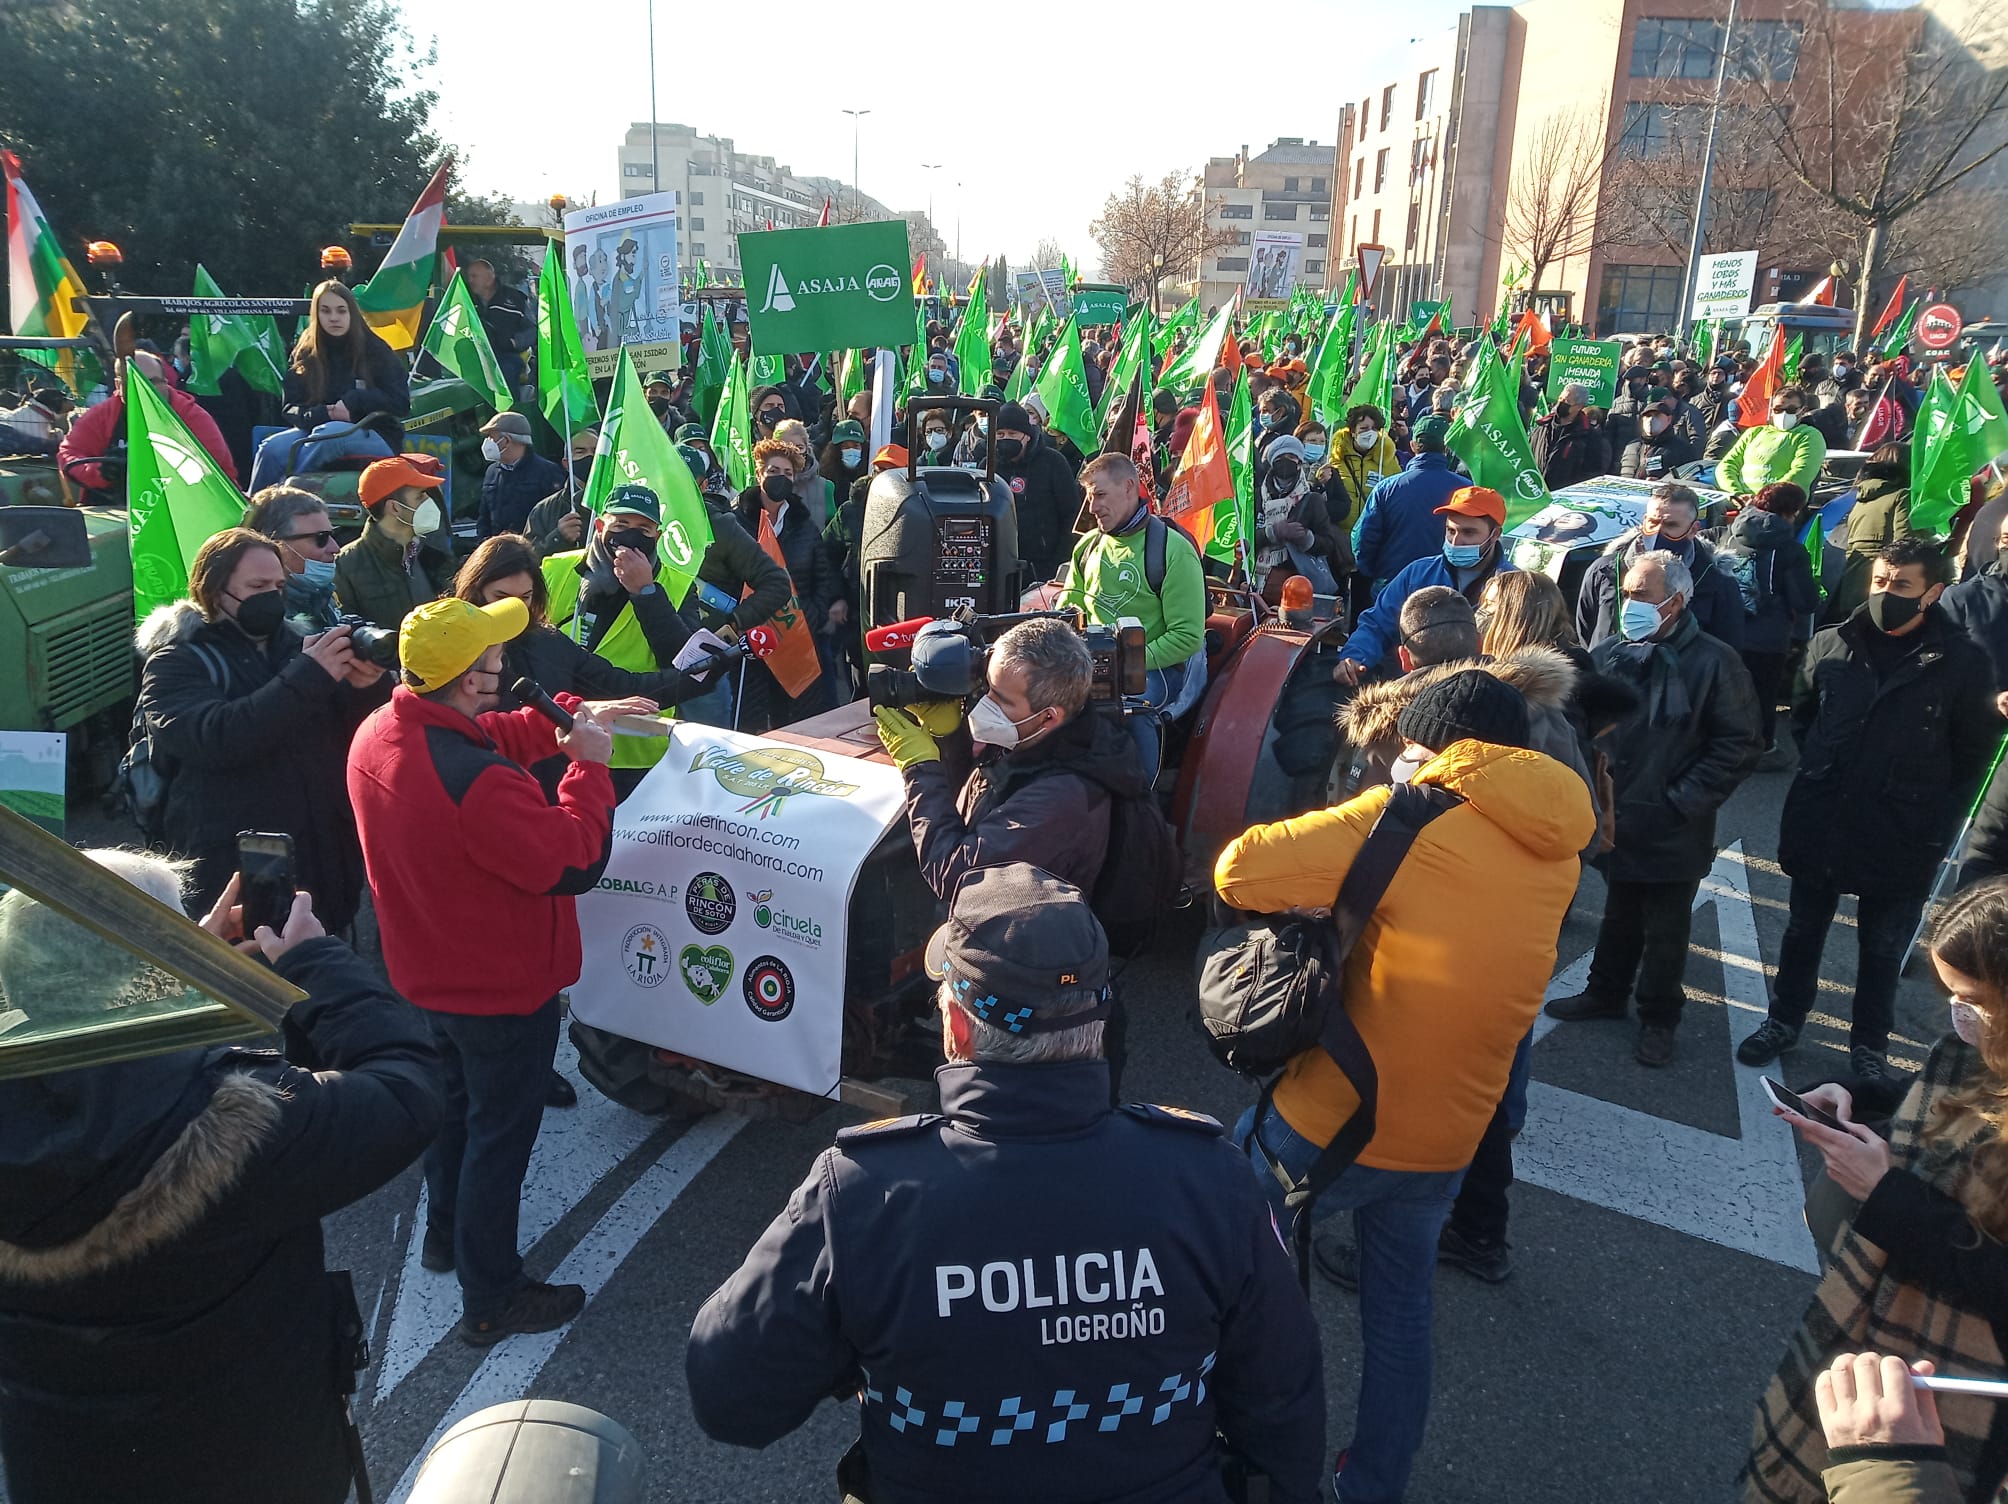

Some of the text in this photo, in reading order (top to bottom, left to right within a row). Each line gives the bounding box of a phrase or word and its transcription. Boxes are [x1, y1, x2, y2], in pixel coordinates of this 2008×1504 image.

[585, 204, 644, 223] OFICINA DE EMPLEO
[1712, 258, 1743, 269] MENOS
[1712, 269, 1740, 279] LOBOS
[797, 276, 900, 295] ASAJA ARAG
[1712, 279, 1737, 289] Y MÁS
[160, 299, 202, 308] TRABAJOS
[1697, 289, 1750, 301] GANADEROS
[643, 347, 668, 358] ISIDRO
[1554, 354, 1567, 363] SIN
[1570, 345, 1601, 355] FUTURO
[594, 366, 603, 374] EN
[603, 364, 611, 373] LA
[1564, 367, 1601, 378] ¡MENUDA
[1480, 422, 1543, 497] ASAJA ARAG
[698, 745, 744, 776] Valle
[747, 768, 775, 781] de
[640, 812, 800, 850] www.vallerincon.com
[612, 829, 823, 885] ww.coliflordecalahorra.com
[692, 877, 731, 901] PERAS DE
[689, 896, 733, 915] RINCÓN
[693, 906, 726, 920] DE SOTO
[773, 909, 822, 937] ciruela
[624, 926, 668, 964] PRODUCCIÓN INTEGRADA
[700, 955, 731, 969] coliflor
[627, 964, 663, 985] LA RIOJA
[748, 960, 792, 995] Alimentos de LA RIOJA
[1060, 974, 1078, 985] PL
[748, 991, 763, 1012] Calidad
[935, 1247, 1165, 1317] POLICIA
[1041, 1301, 1166, 1346] LOGROÑO
